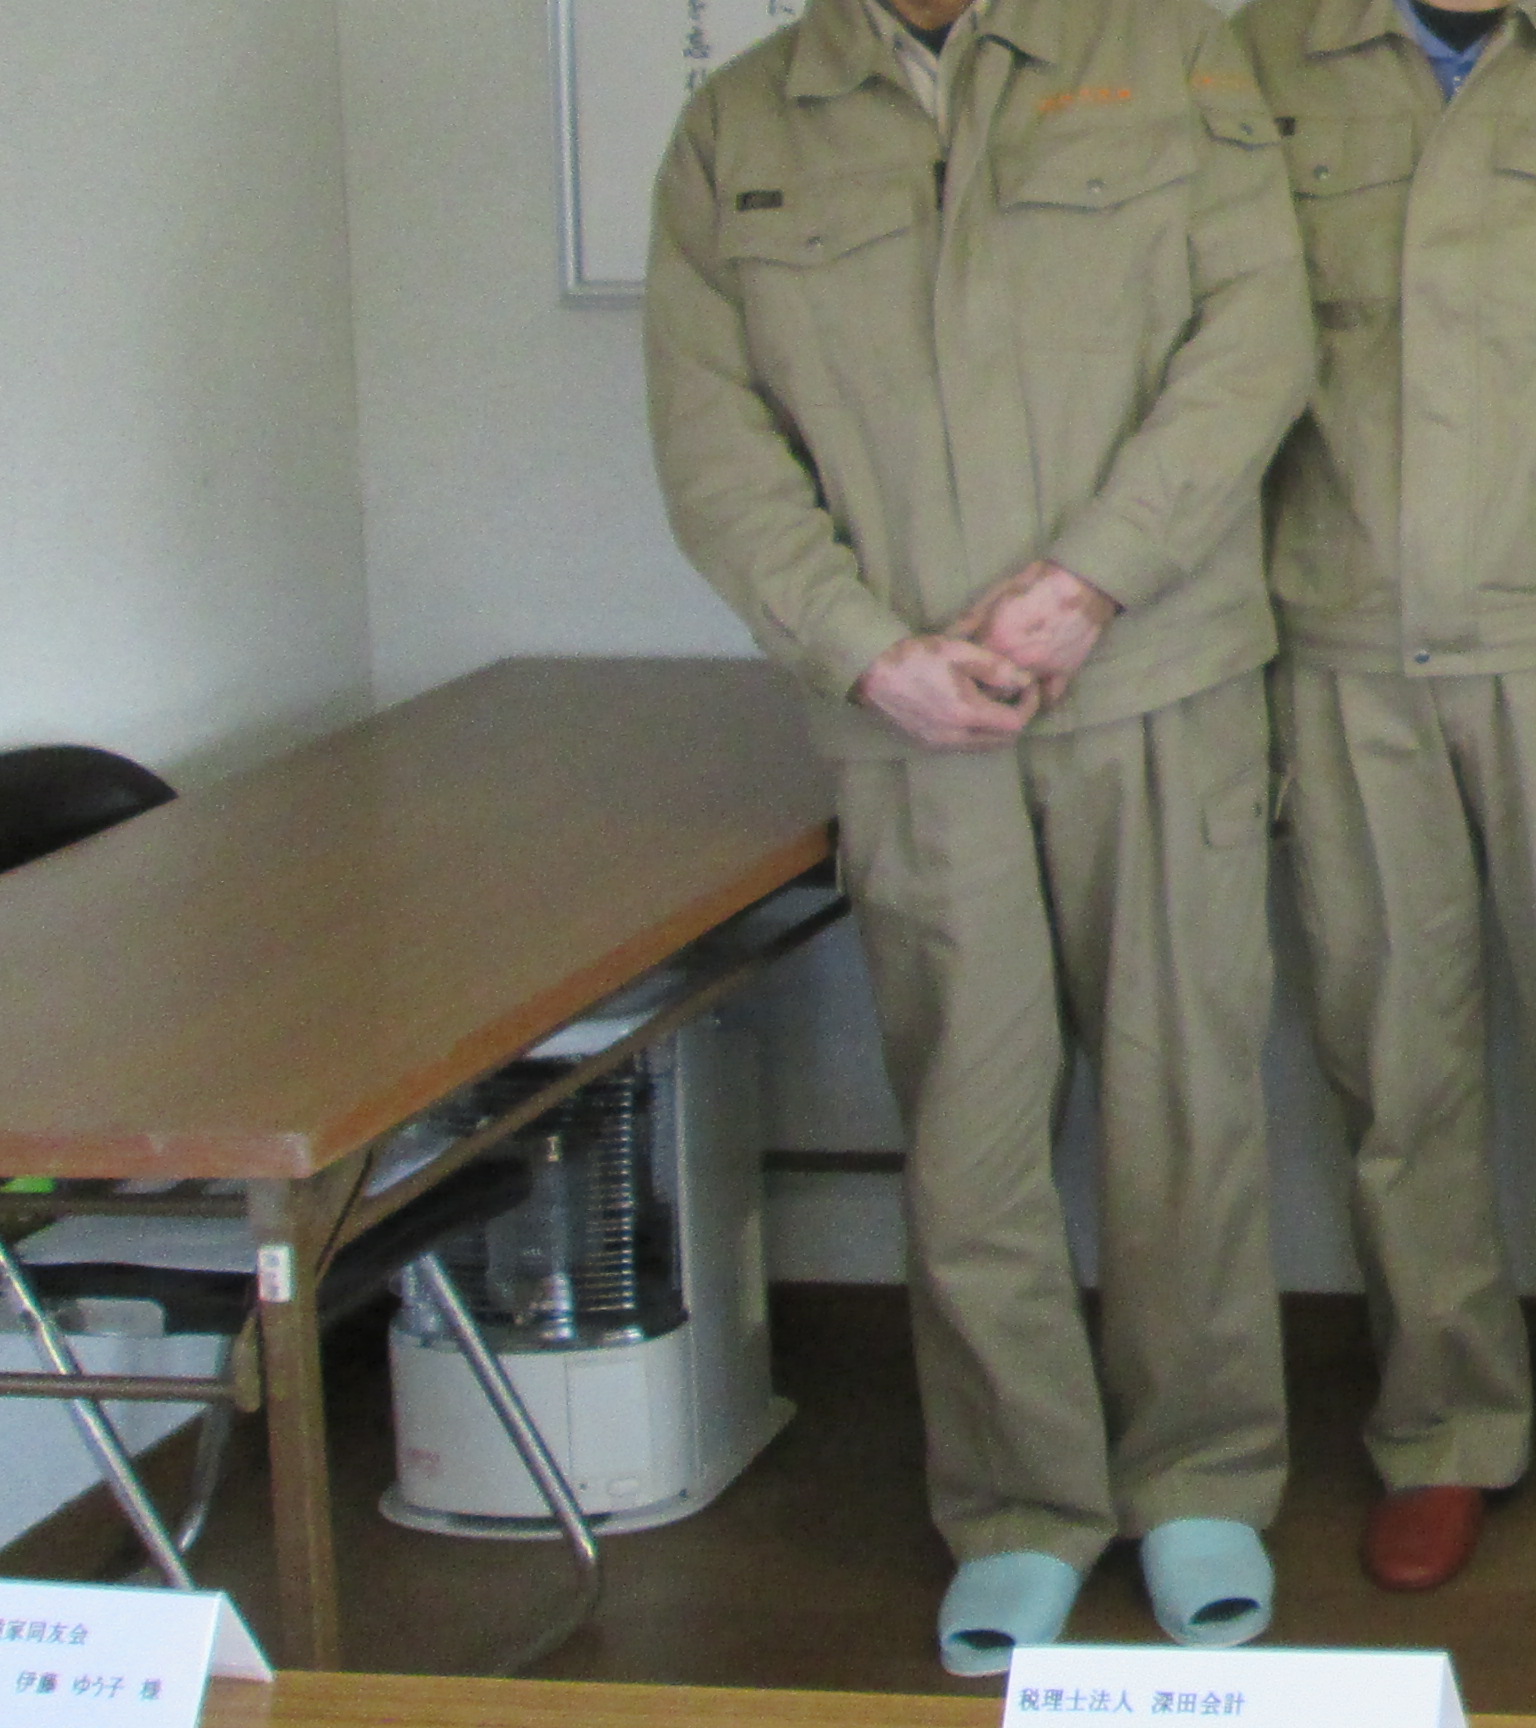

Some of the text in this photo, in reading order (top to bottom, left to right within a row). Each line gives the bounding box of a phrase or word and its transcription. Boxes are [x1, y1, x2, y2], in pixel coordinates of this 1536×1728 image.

[0, 1618, 89, 1646] 家同友会
[71, 1674, 125, 1699] ゆう子
[1018, 1687, 1246, 1716] 税理士法人 深田会計
